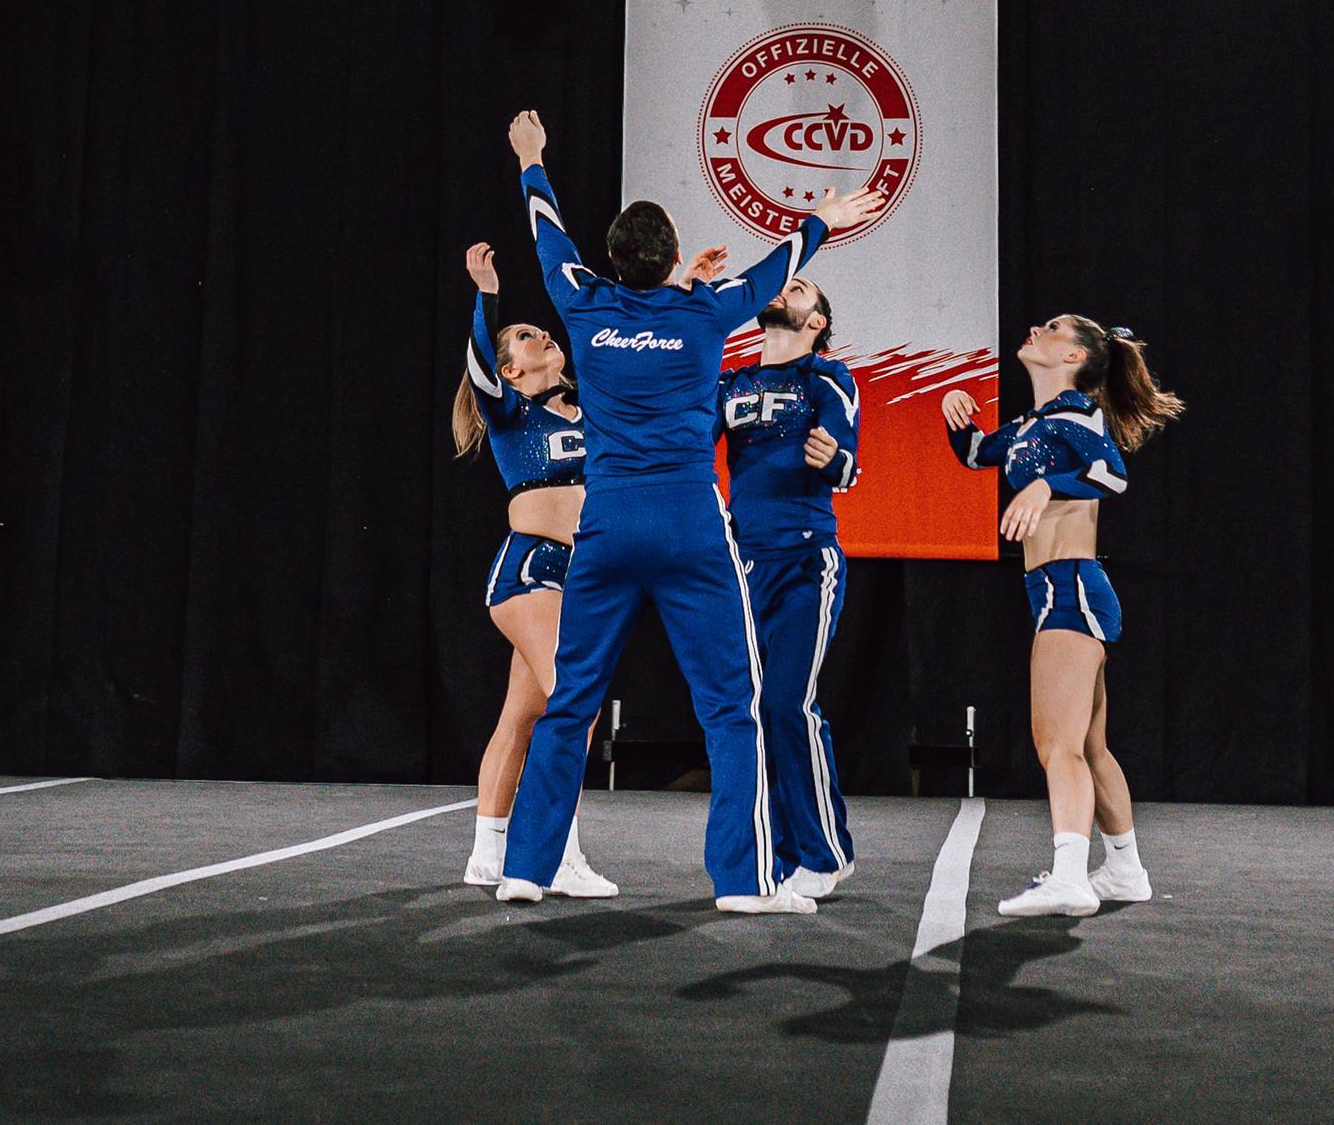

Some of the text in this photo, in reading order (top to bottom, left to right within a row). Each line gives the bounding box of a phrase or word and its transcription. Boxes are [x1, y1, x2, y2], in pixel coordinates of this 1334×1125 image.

[741, 39, 879, 78] OFFIZIELLE
[784, 122, 873, 151] CCVD
[717, 163, 899, 233] MEISTEFT
[590, 328, 683, 352] CheerForce
[725, 391, 798, 429] CF
